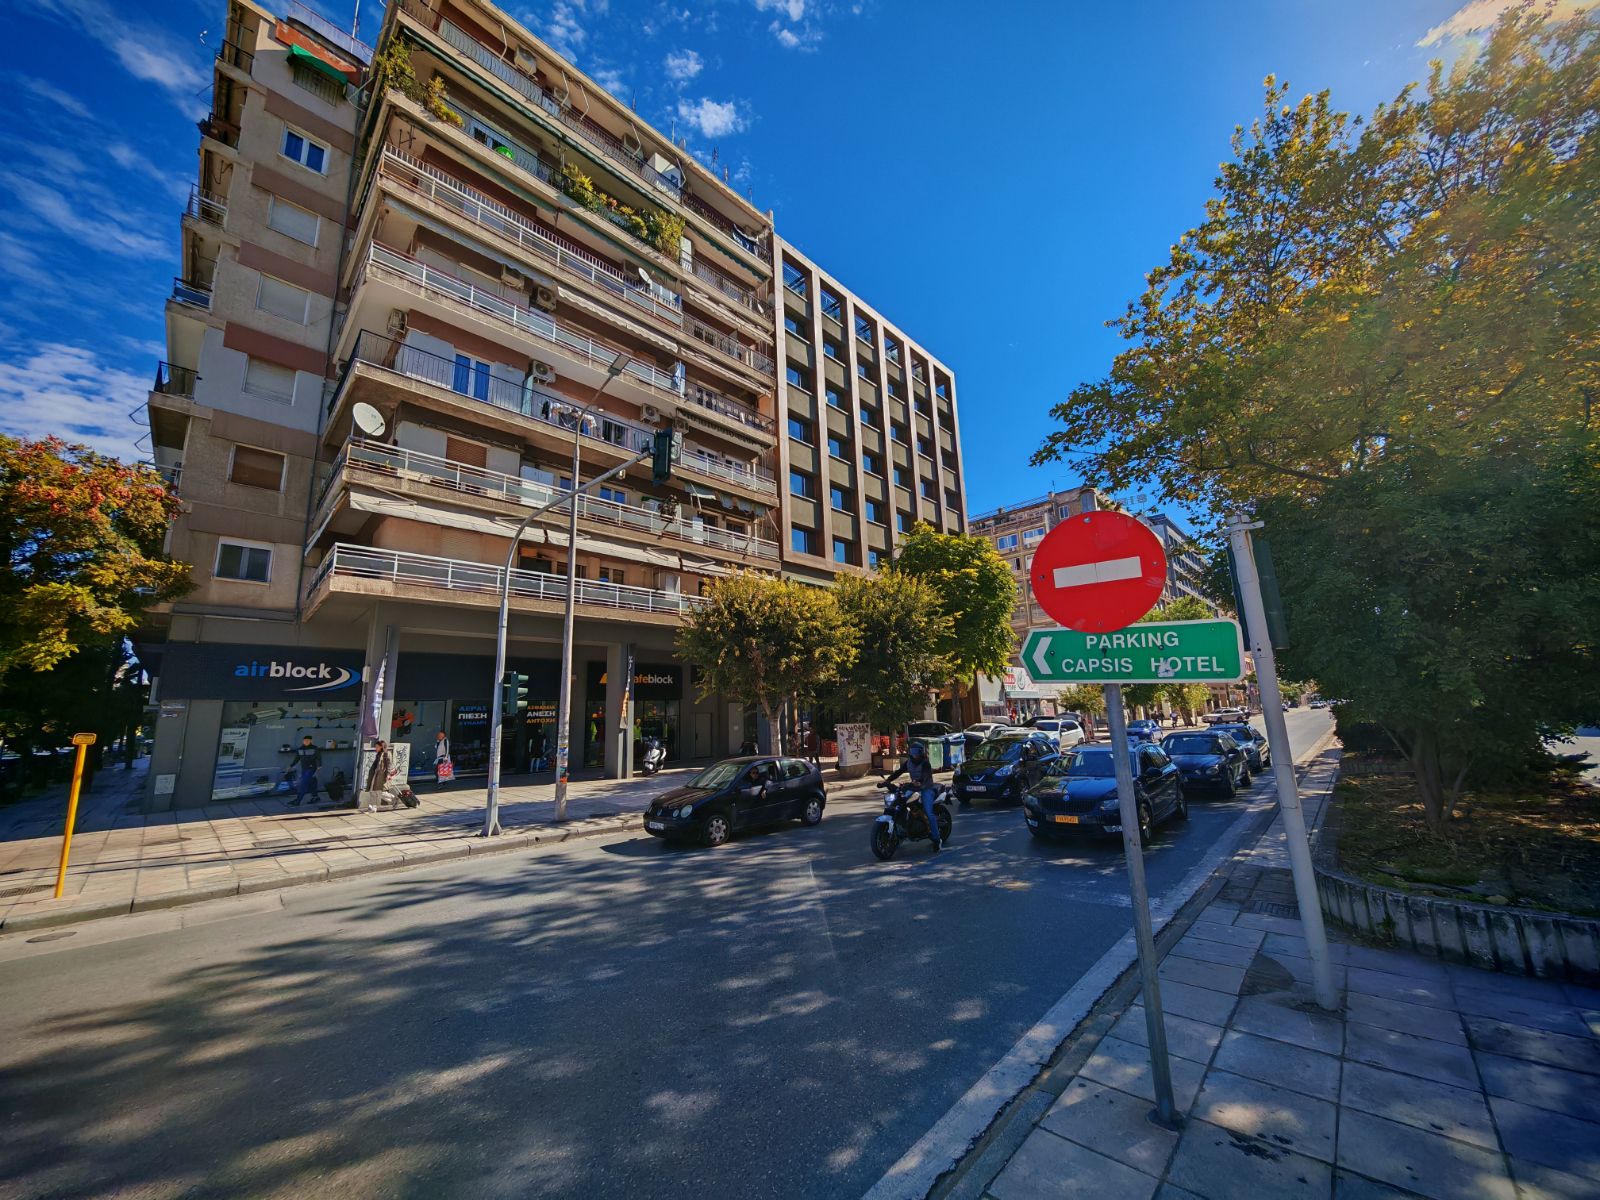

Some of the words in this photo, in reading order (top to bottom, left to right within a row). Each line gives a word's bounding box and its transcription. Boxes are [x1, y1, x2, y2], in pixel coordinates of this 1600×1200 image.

[1086, 631, 1180, 650] PARKING
[234, 661, 332, 679] airblock
[1061, 657, 1134, 673] CAPSIS
[1151, 656, 1225, 673] HOTEL
[633, 674, 673, 684] afeblock
[526, 710, 556, 718] ΑΝΕΣΗ
